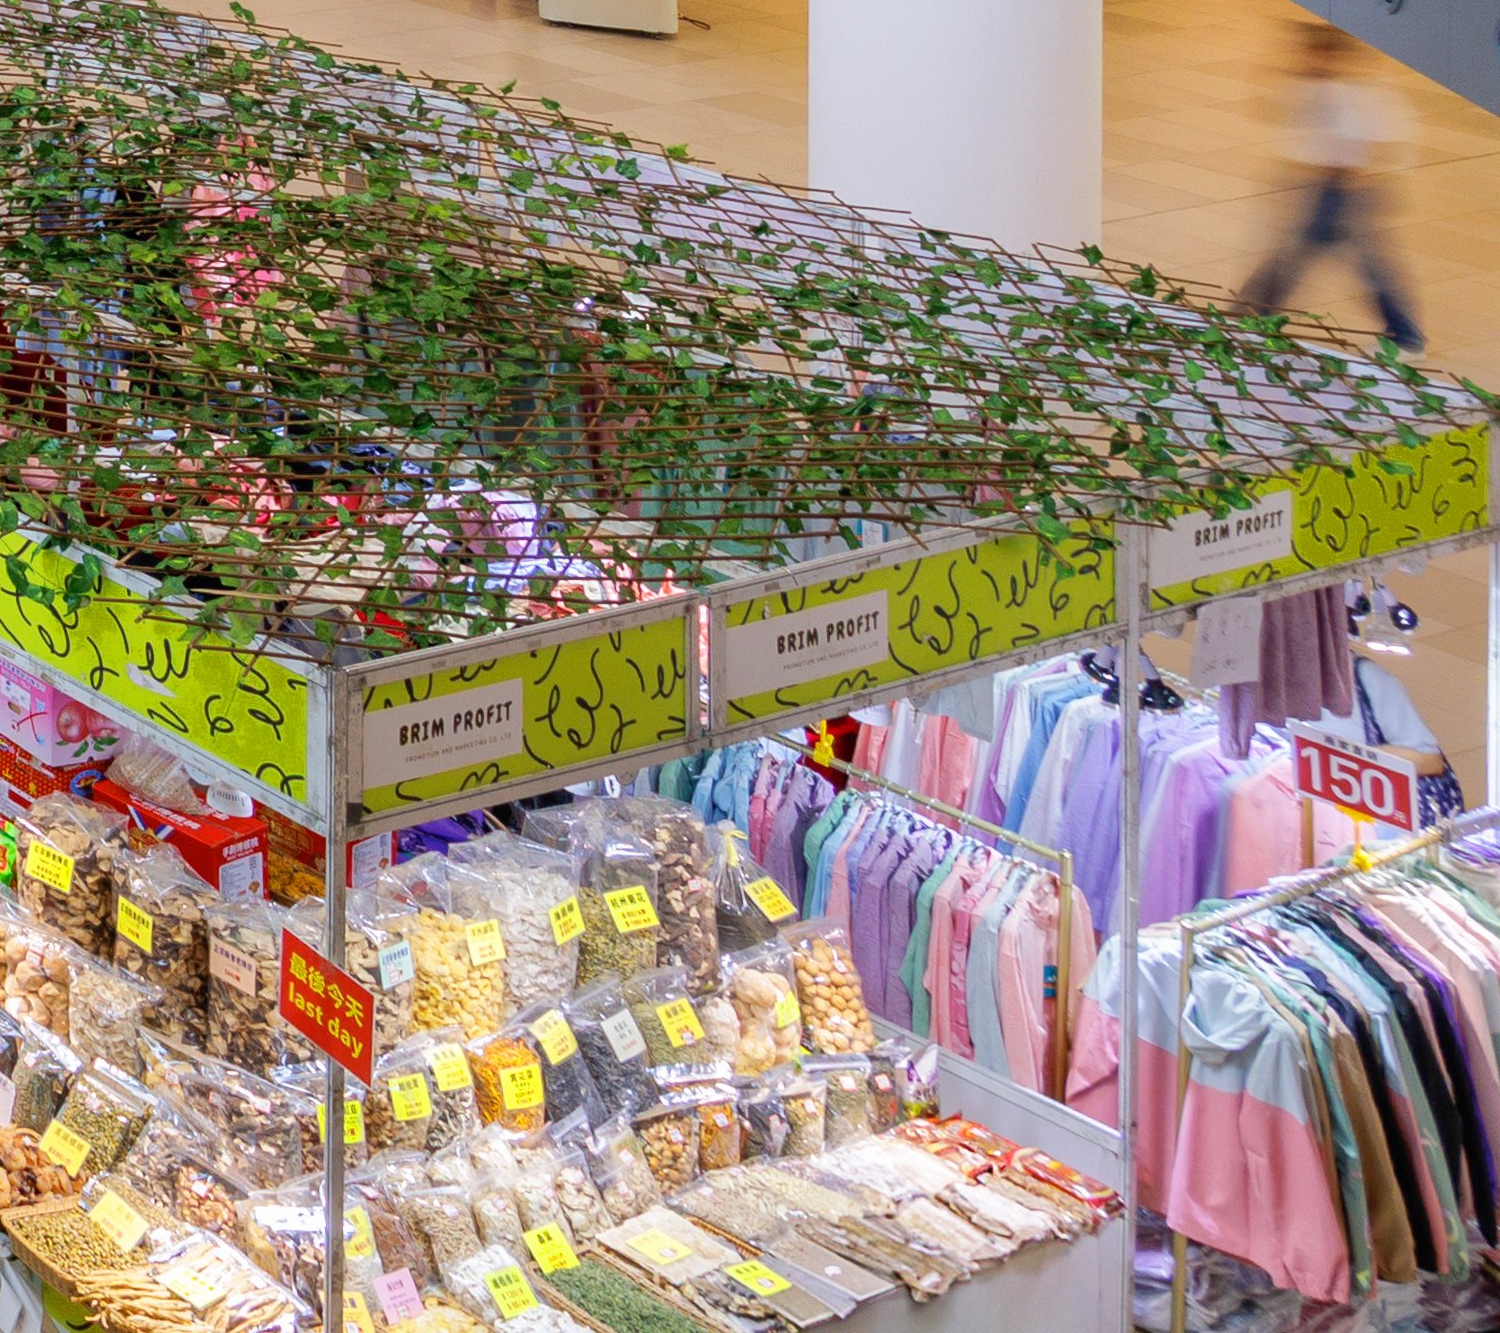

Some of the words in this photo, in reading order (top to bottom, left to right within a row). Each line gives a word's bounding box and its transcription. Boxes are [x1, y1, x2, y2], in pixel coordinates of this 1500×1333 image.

[1195, 523, 1230, 547] BRIM
[1236, 510, 1283, 536] PROFIT
[776, 627, 819, 655] BRIM
[826, 610, 879, 643] PROFIT
[399, 717, 444, 746] BRIM
[453, 700, 512, 734] PROFIT
[1301, 746, 1394, 816] 150
[289, 951, 364, 1028] 最後今天
[288, 981, 324, 1026] last
[327, 1016, 364, 1059] day
